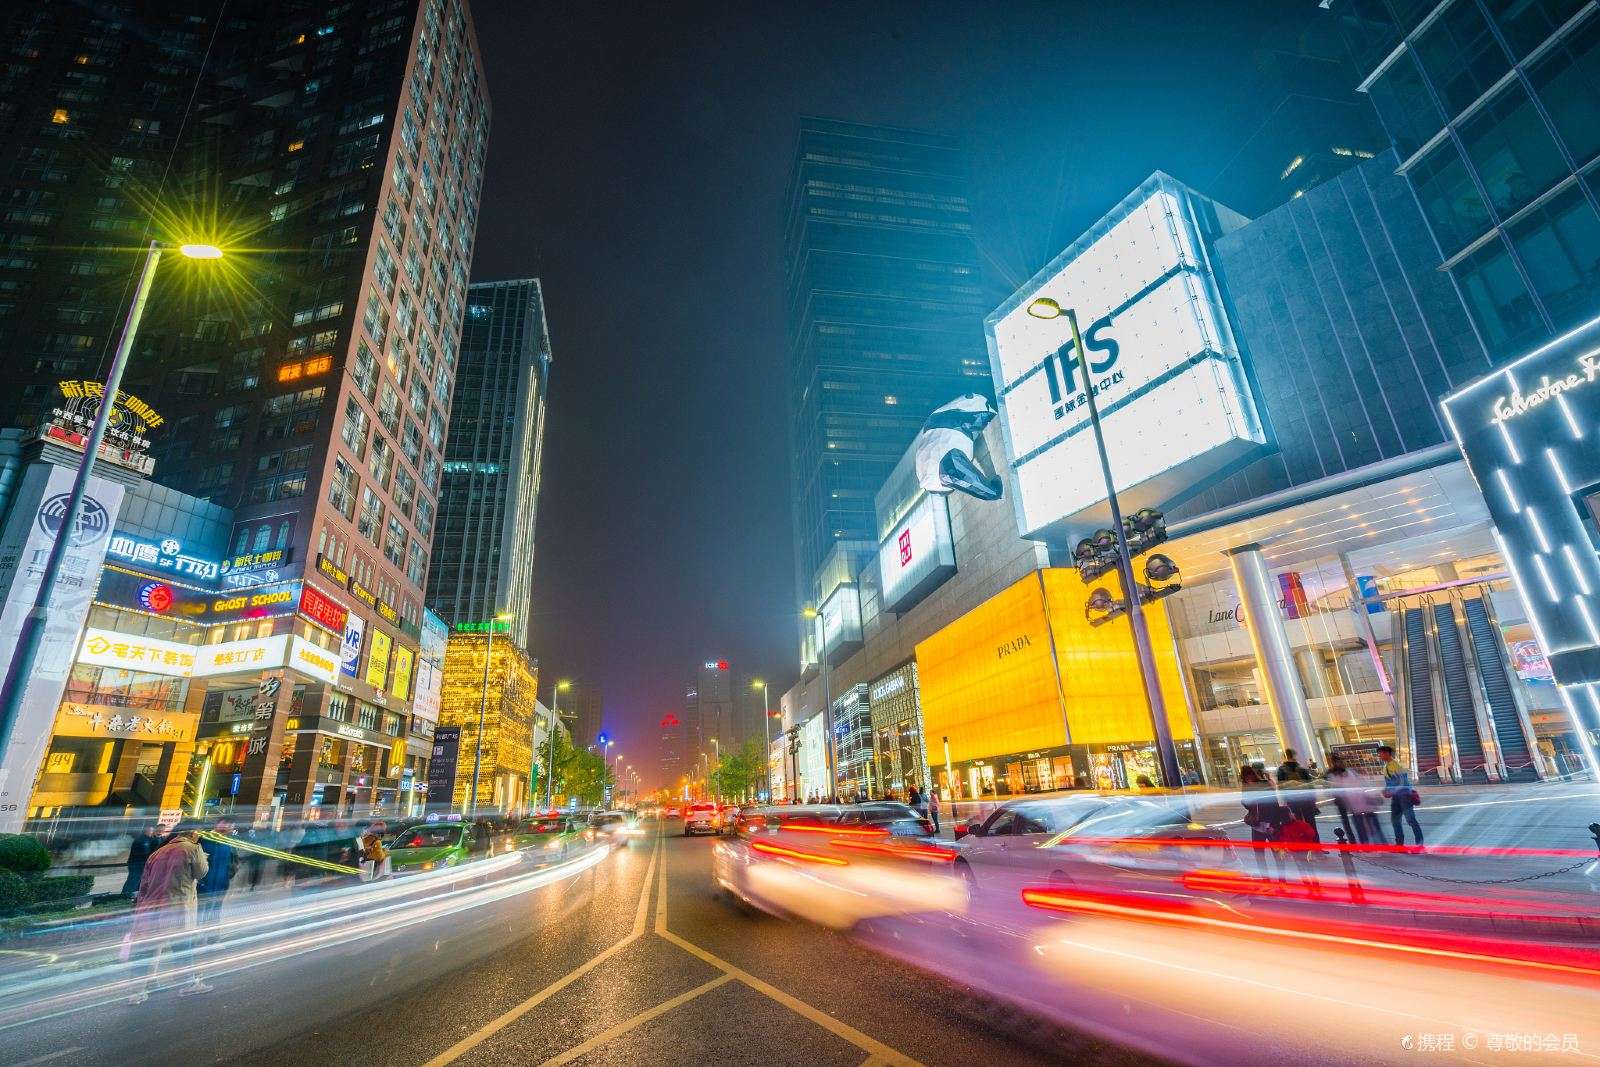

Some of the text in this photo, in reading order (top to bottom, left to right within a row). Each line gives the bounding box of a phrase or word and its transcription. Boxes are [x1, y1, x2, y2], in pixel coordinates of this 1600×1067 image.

[1043, 314, 1119, 405] IFS
[213, 591, 292, 611] GHOST SCHOOL
[1208, 609, 1233, 623] Lane
[345, 626, 361, 649] VR
[997, 634, 1030, 659] PRADA
[249, 702, 276, 755] 第一城
